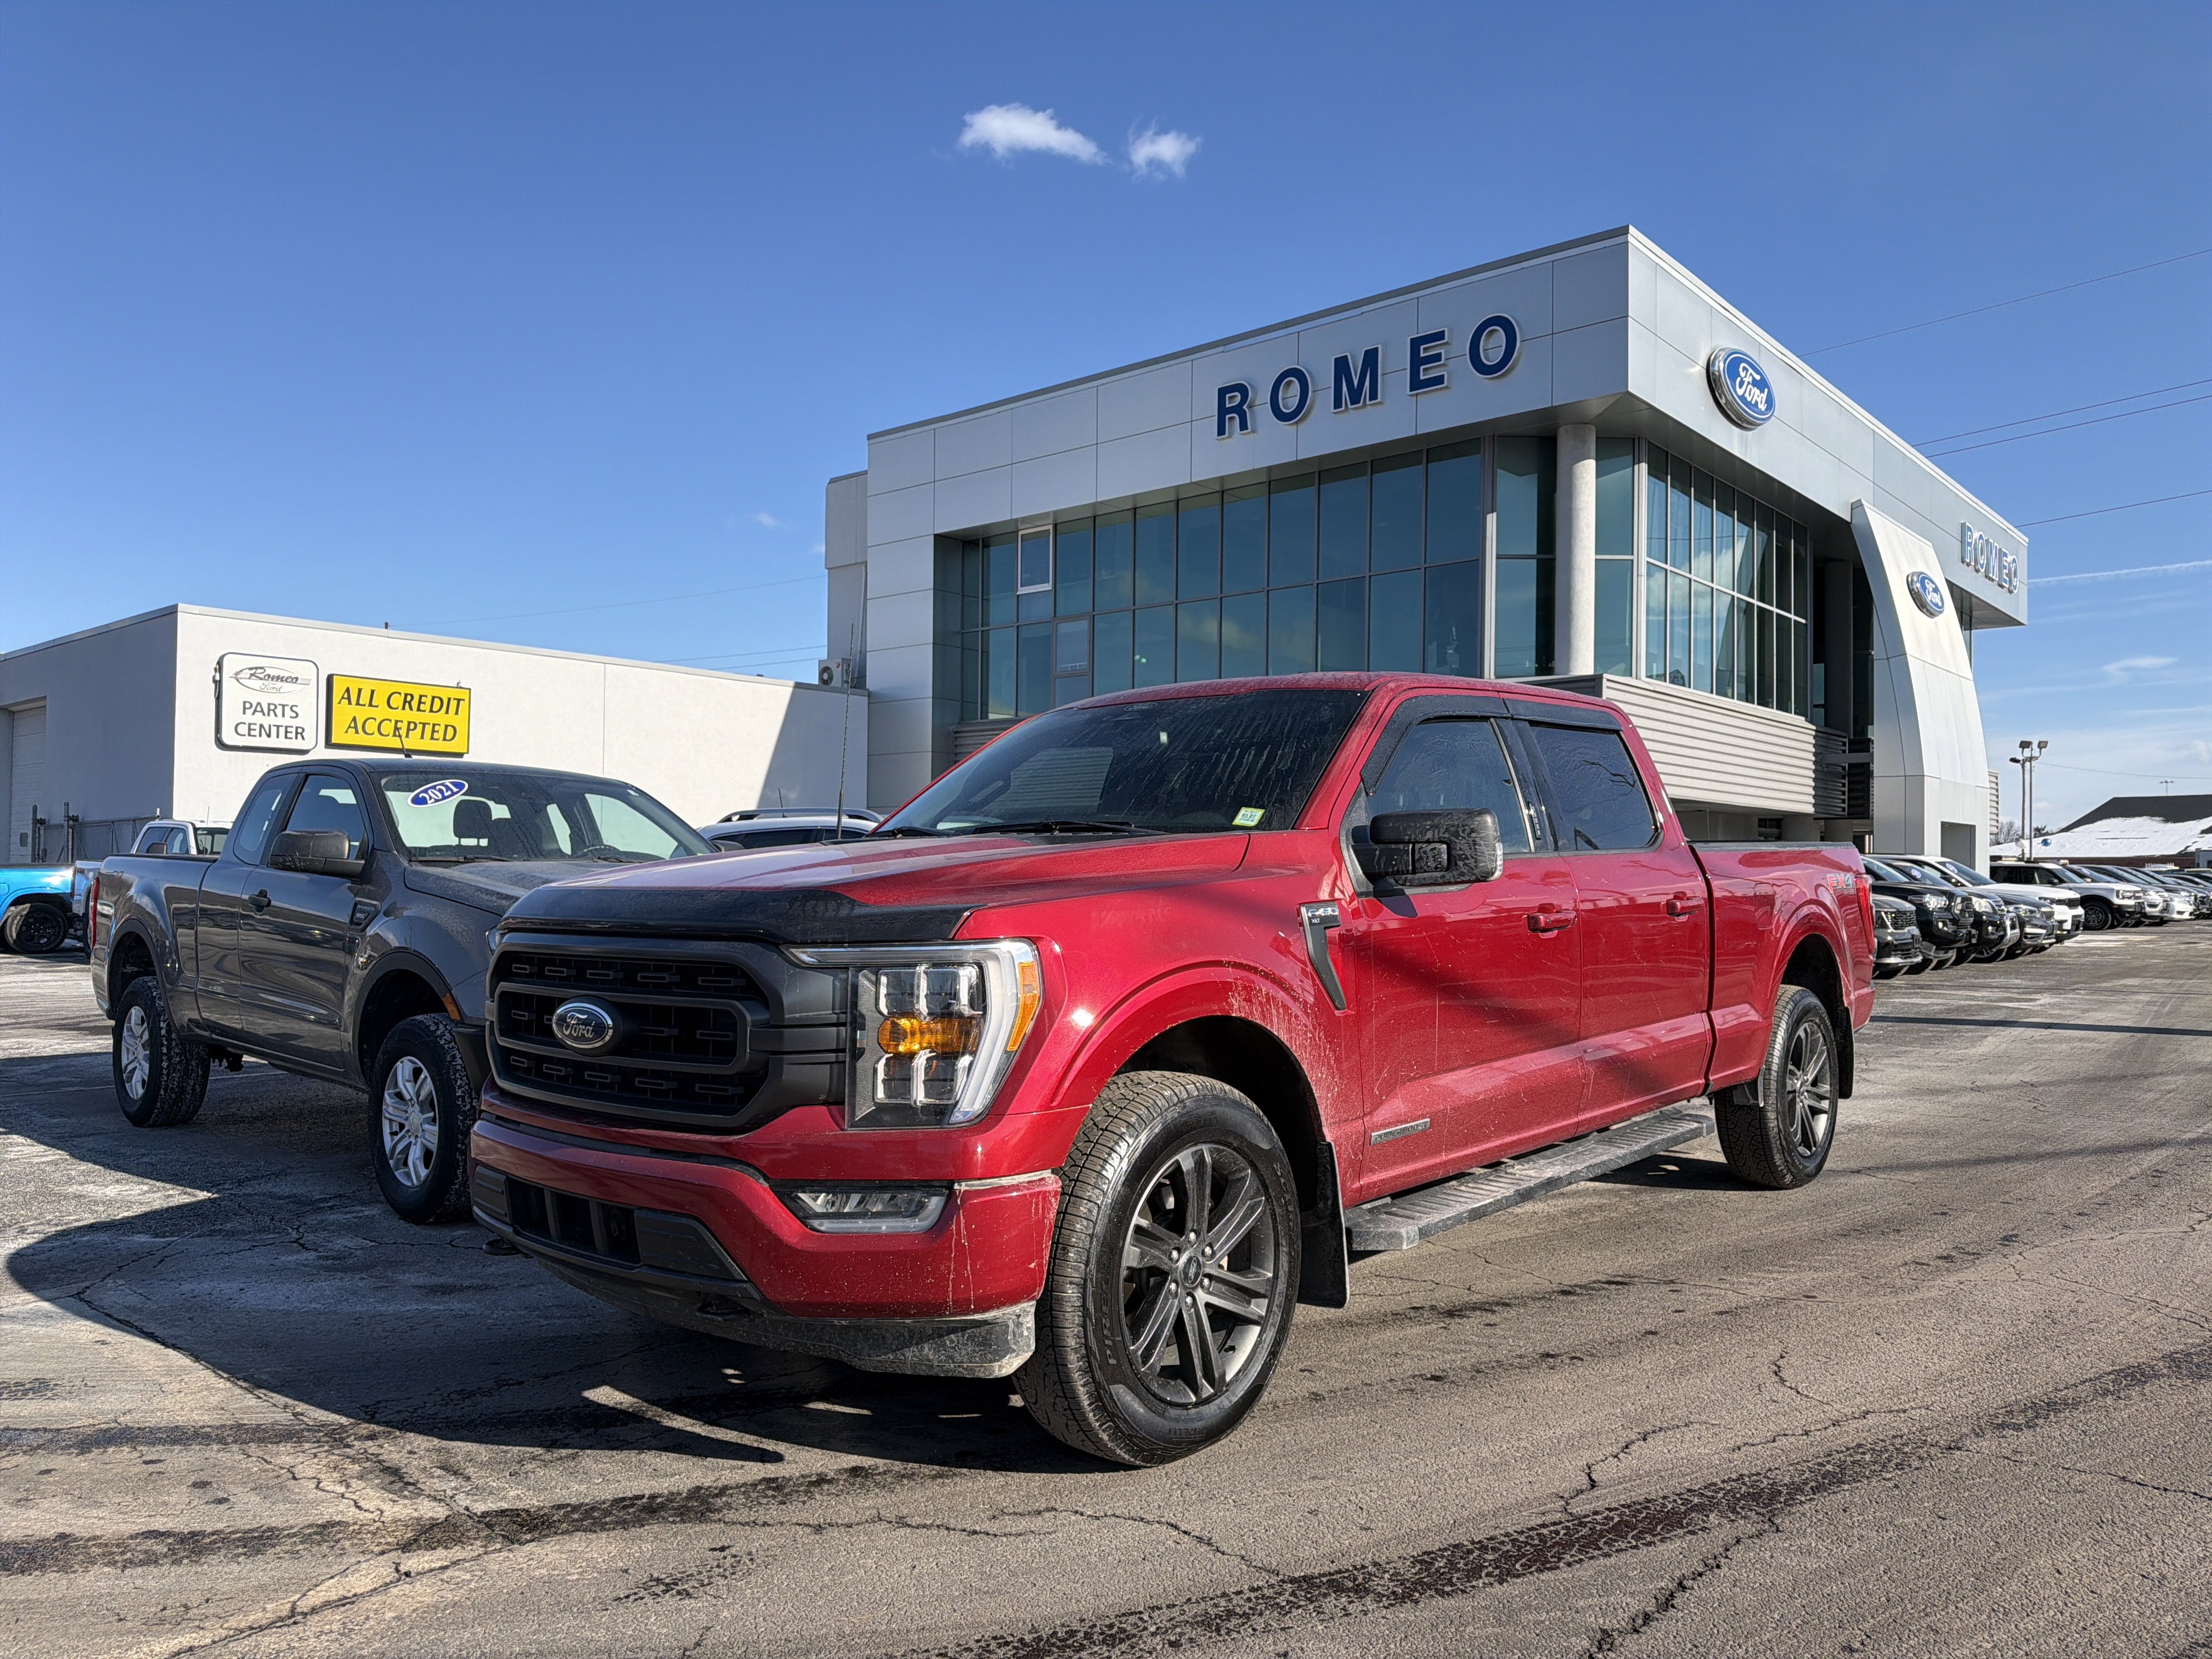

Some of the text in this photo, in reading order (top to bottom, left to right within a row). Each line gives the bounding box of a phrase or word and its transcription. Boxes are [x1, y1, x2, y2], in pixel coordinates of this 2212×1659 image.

[1215, 313, 1521, 441] ROMEO
[1735, 362, 1769, 411] Ford
[1962, 522, 2020, 594] ROMEO
[1925, 579, 1942, 607] Ford
[247, 666, 299, 684] Romeo
[259, 681, 283, 693] Ford
[242, 700, 300, 719] PARTS
[337, 686, 466, 716] ALL CREDIT
[234, 721, 306, 741] CENTER
[344, 715, 458, 742] ACCEPTED
[419, 781, 460, 804] 2021
[1826, 873, 1854, 894] FX4
[563, 1012, 595, 1039] Ford
[1374, 1122, 1429, 1142] POWERBOOST
